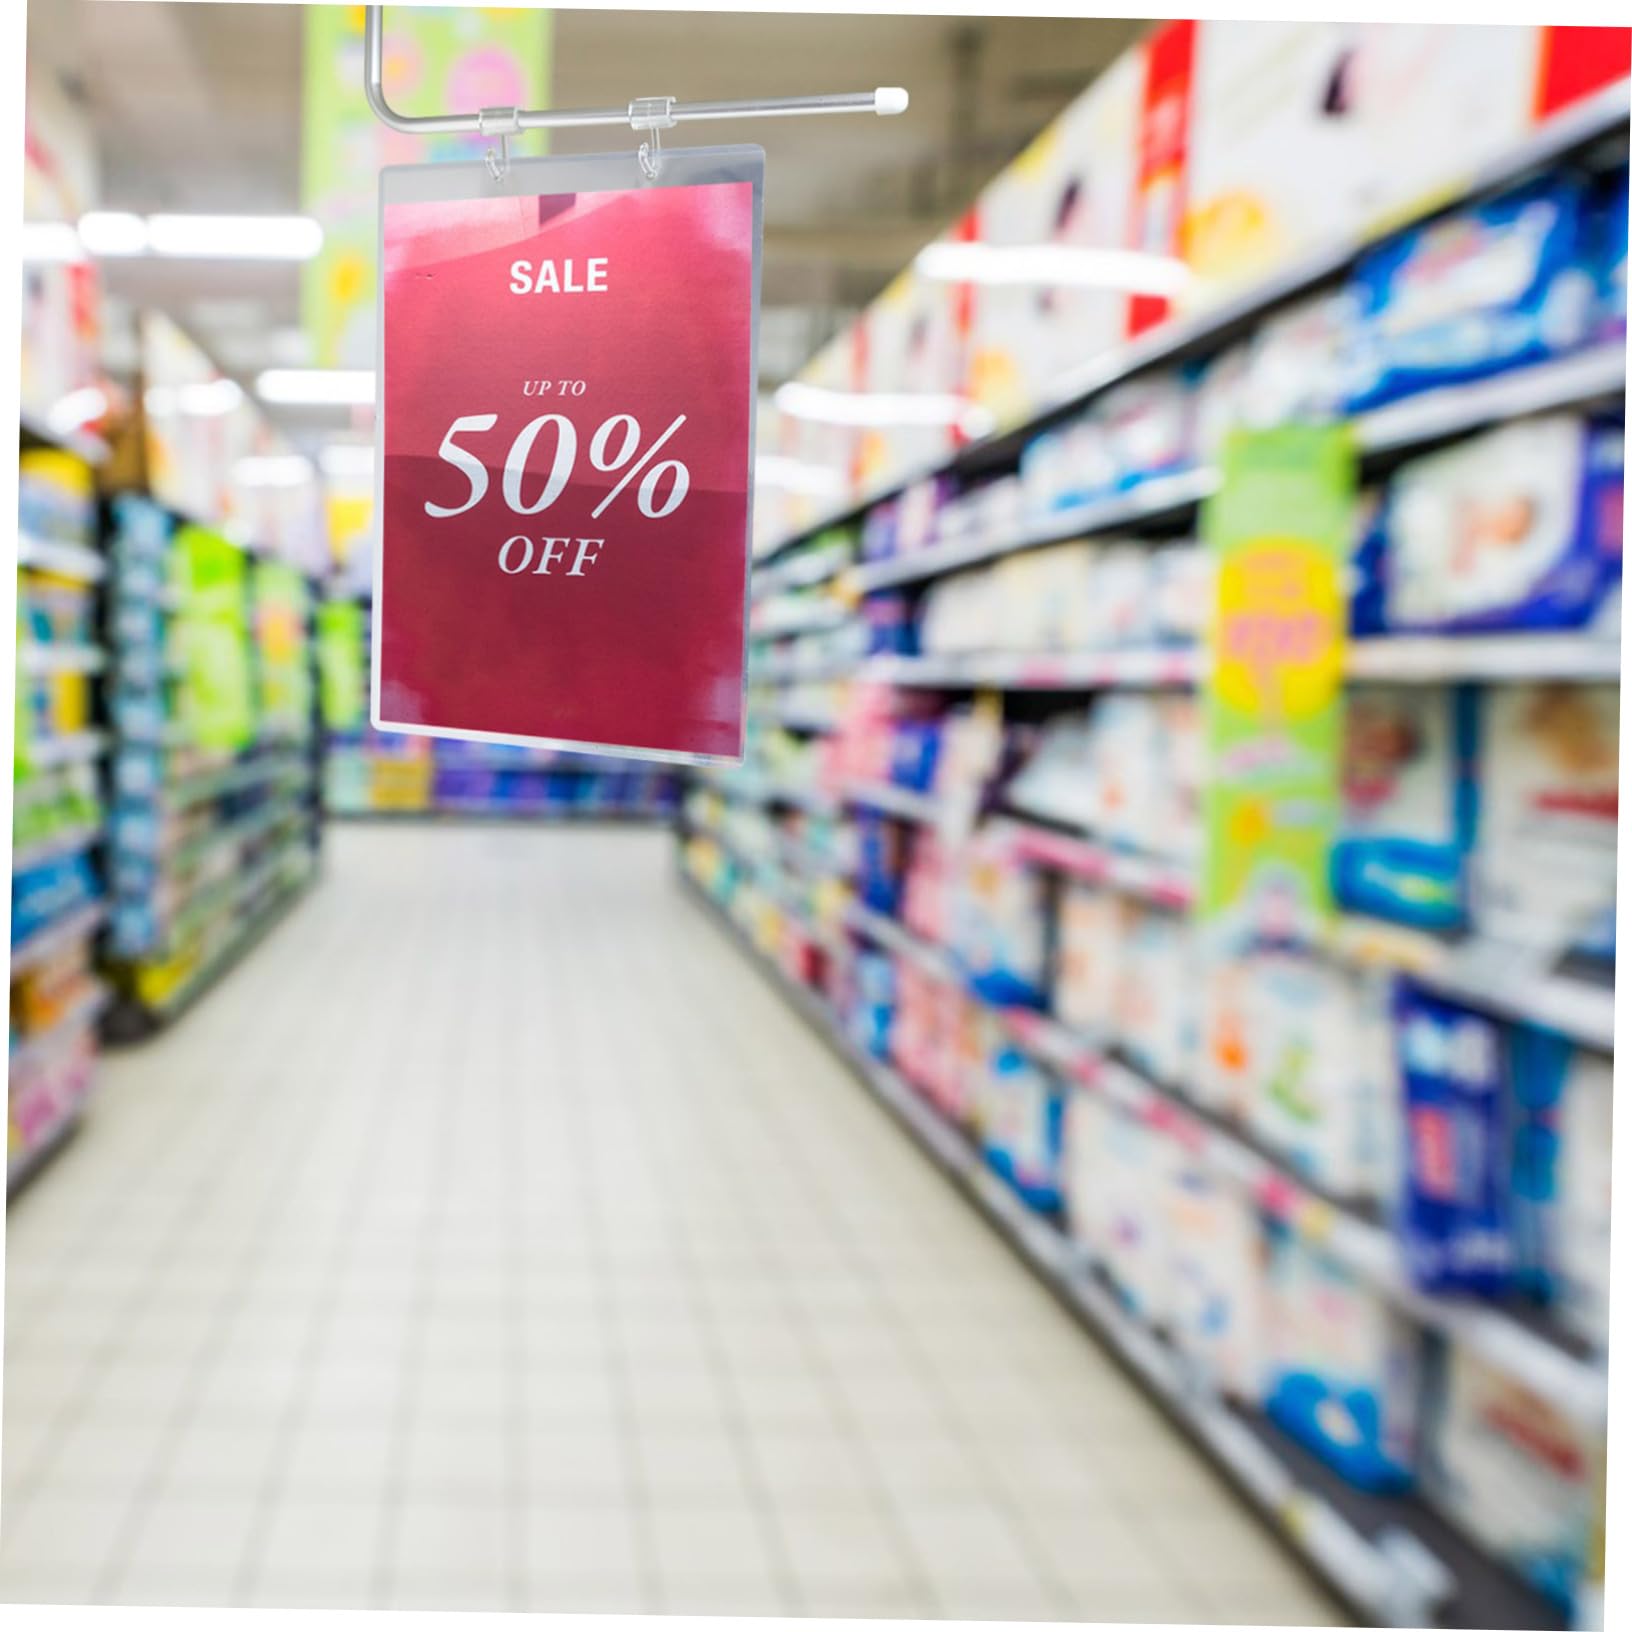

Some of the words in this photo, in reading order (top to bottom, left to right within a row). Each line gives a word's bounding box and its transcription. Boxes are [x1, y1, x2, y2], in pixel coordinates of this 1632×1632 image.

[510, 258, 608, 294] SALE
[523, 381, 551, 396] UP
[559, 381, 586, 396] TO
[425, 414, 689, 518] 50%
[499, 536, 604, 575] OFF
